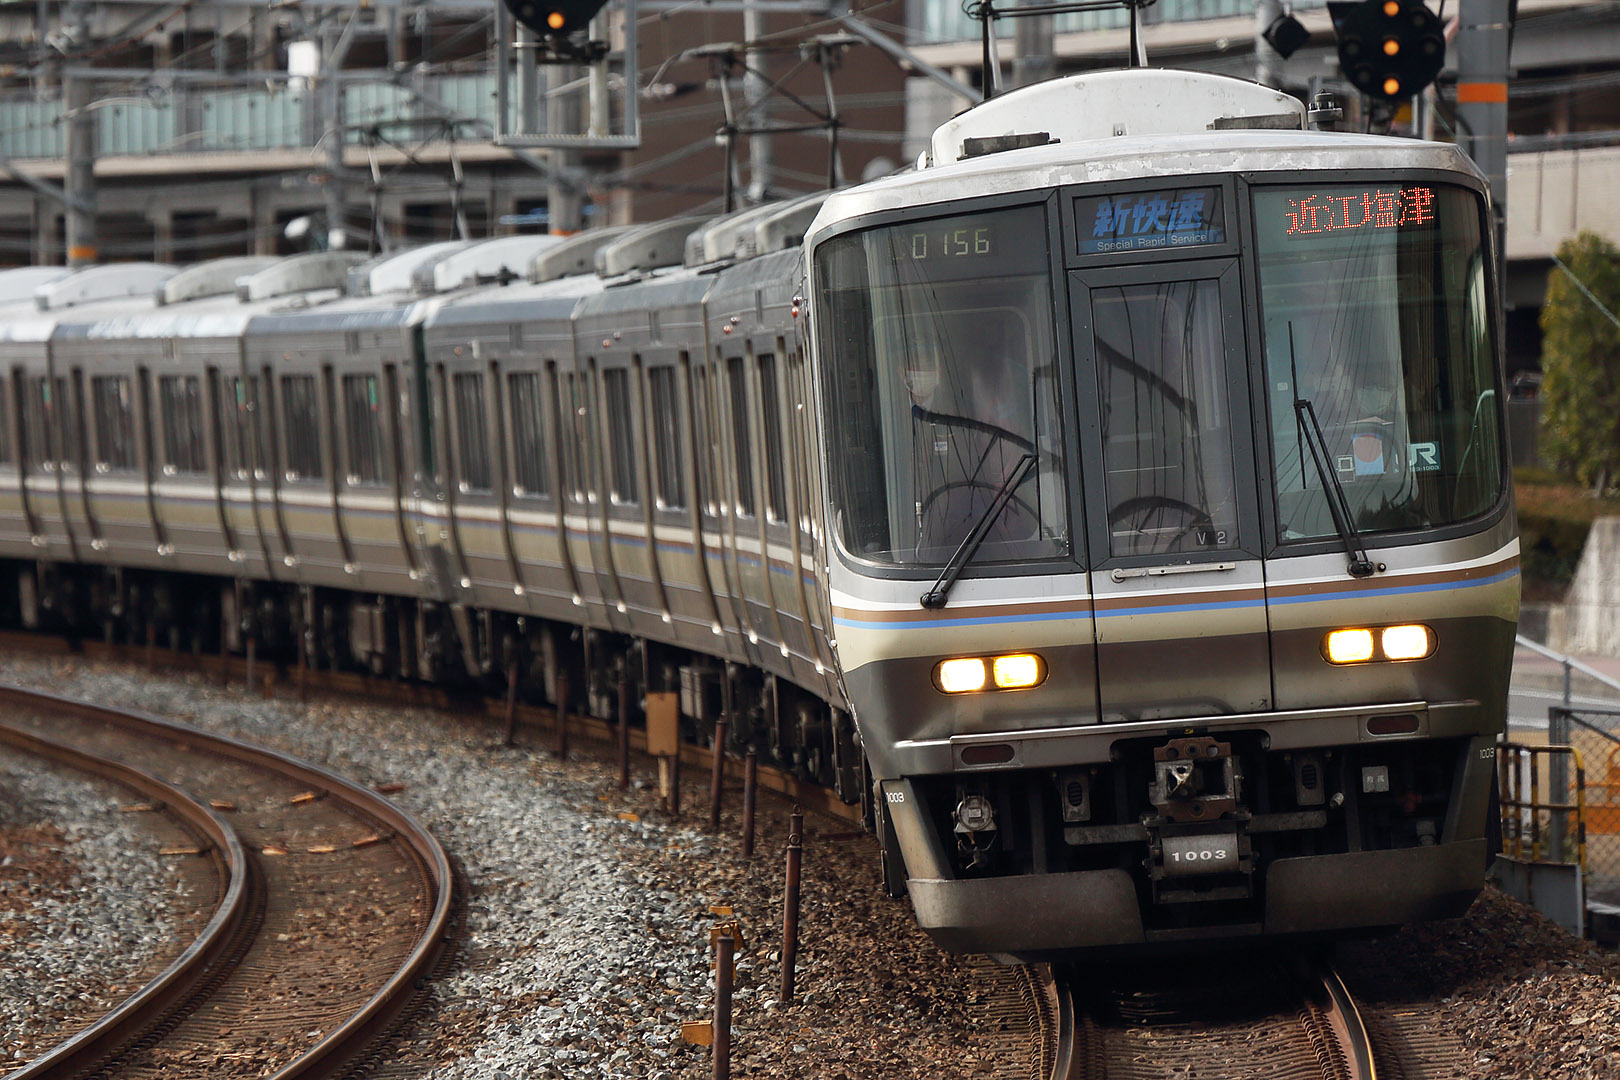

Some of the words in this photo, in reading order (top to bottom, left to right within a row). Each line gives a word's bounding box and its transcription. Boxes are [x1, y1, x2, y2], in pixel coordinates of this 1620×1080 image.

[1092, 191, 1206, 237] 新快速
[1285, 187, 1434, 235] 近江塩津
[912, 228, 990, 259] 0156
[1097, 240, 1134, 252] Special
[1138, 237, 1167, 248] Rapid
[1171, 233, 1208, 245] Service
[1479, 747, 1495, 760] 1003
[885, 791, 905, 803] 1003
[1171, 849, 1227, 862] 1003
